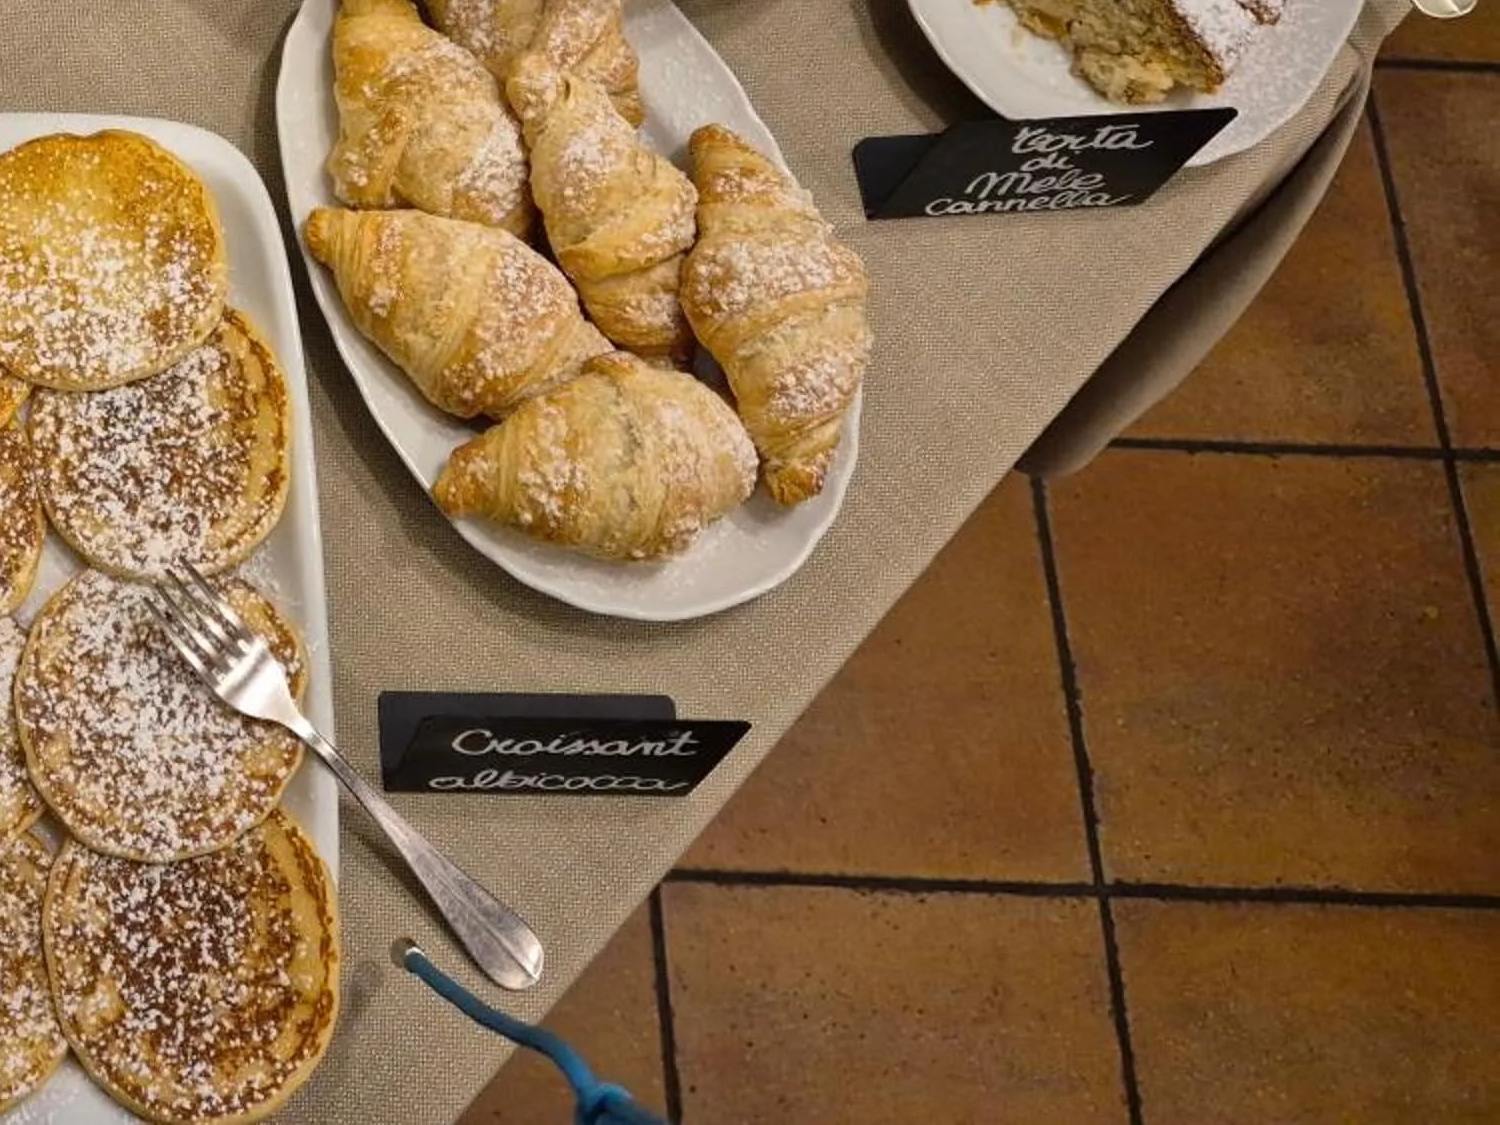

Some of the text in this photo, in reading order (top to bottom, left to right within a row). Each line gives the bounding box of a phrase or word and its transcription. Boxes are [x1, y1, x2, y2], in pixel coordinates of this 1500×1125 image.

[1011, 124, 1155, 156] Torta
[1019, 151, 1075, 173] di
[963, 171, 1107, 199] Mele
[450, 727, 702, 757] Croissant
